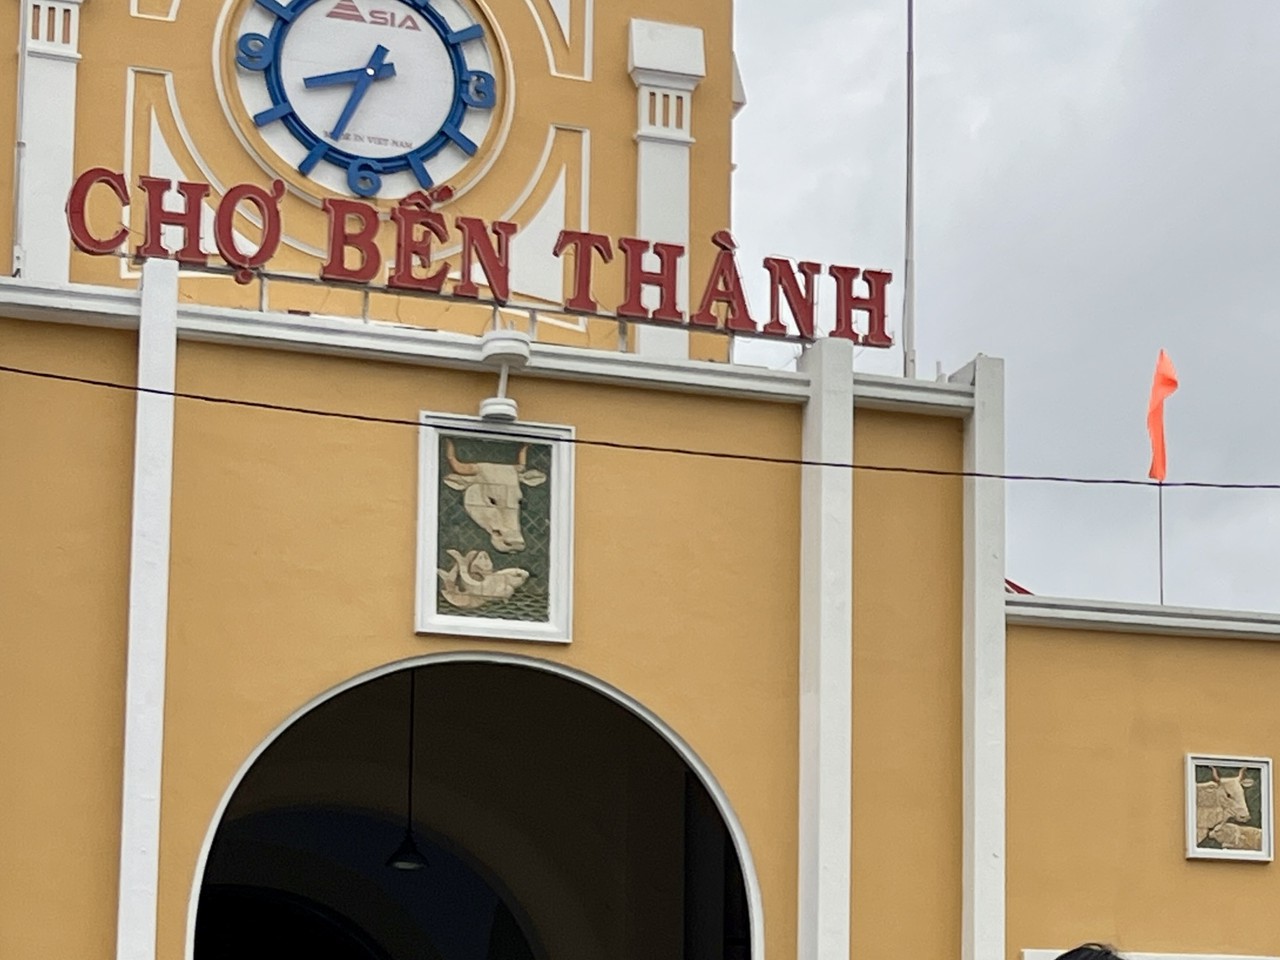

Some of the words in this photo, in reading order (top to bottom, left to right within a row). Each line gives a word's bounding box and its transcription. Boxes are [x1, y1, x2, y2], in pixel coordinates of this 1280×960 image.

[65, 166, 287, 286] CHỢ
[320, 184, 520, 306] BẾN
[552, 229, 896, 349] THÀNH
